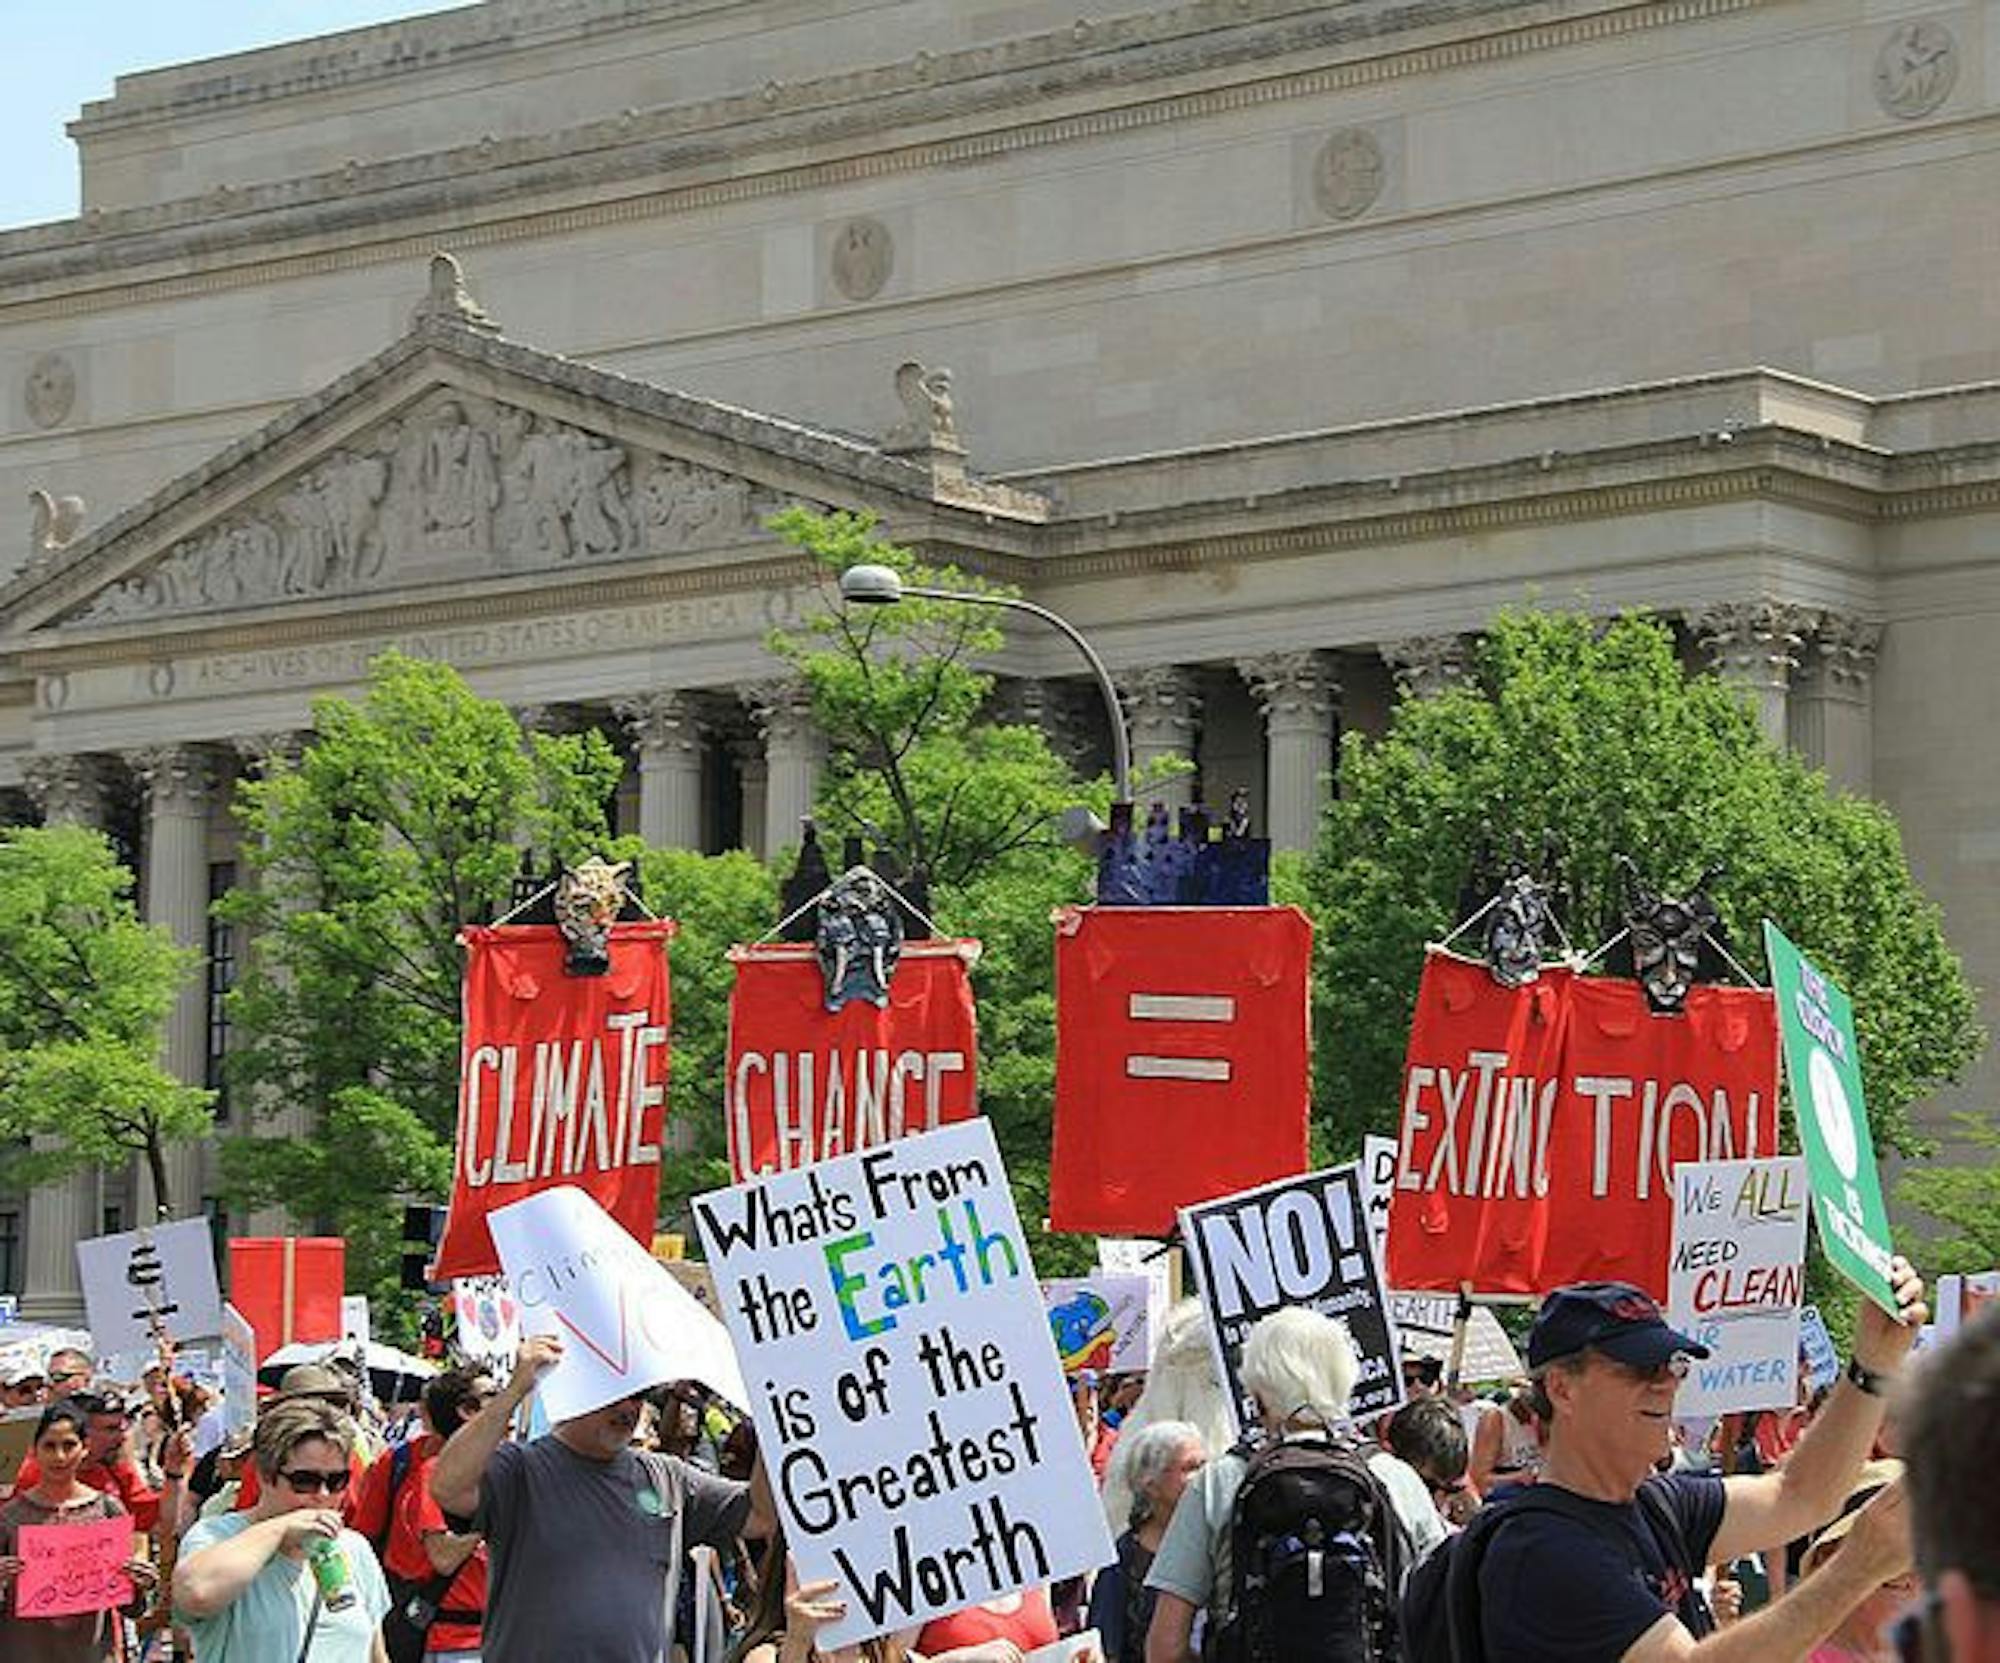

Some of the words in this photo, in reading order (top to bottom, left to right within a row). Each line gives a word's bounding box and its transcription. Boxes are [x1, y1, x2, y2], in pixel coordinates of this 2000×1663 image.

[197, 649, 307, 682] ARCHIVES
[492, 617, 577, 655] STATES
[582, 610, 617, 645] OF
[622, 599, 741, 641] AMERICA
[463, 1010, 667, 1187] CLIMATE
[863, 1151, 988, 1220] From
[1683, 1175, 1722, 1216] We
[1732, 1168, 1800, 1217] ALL
[739, 1273, 818, 1344] the
[822, 1198, 1020, 1342] Earth
[1201, 1180, 1366, 1318] NO!
[1672, 1240, 1738, 1272] NEED
[1694, 1264, 1801, 1314] CLEAN
[765, 1381, 816, 1443] is
[838, 1347, 890, 1422] of
[919, 1328, 1004, 1397] the
[1699, 1358, 1788, 1392] WATER
[780, 1382, 1041, 1536] Greatest
[832, 1496, 1051, 1626] Worth
